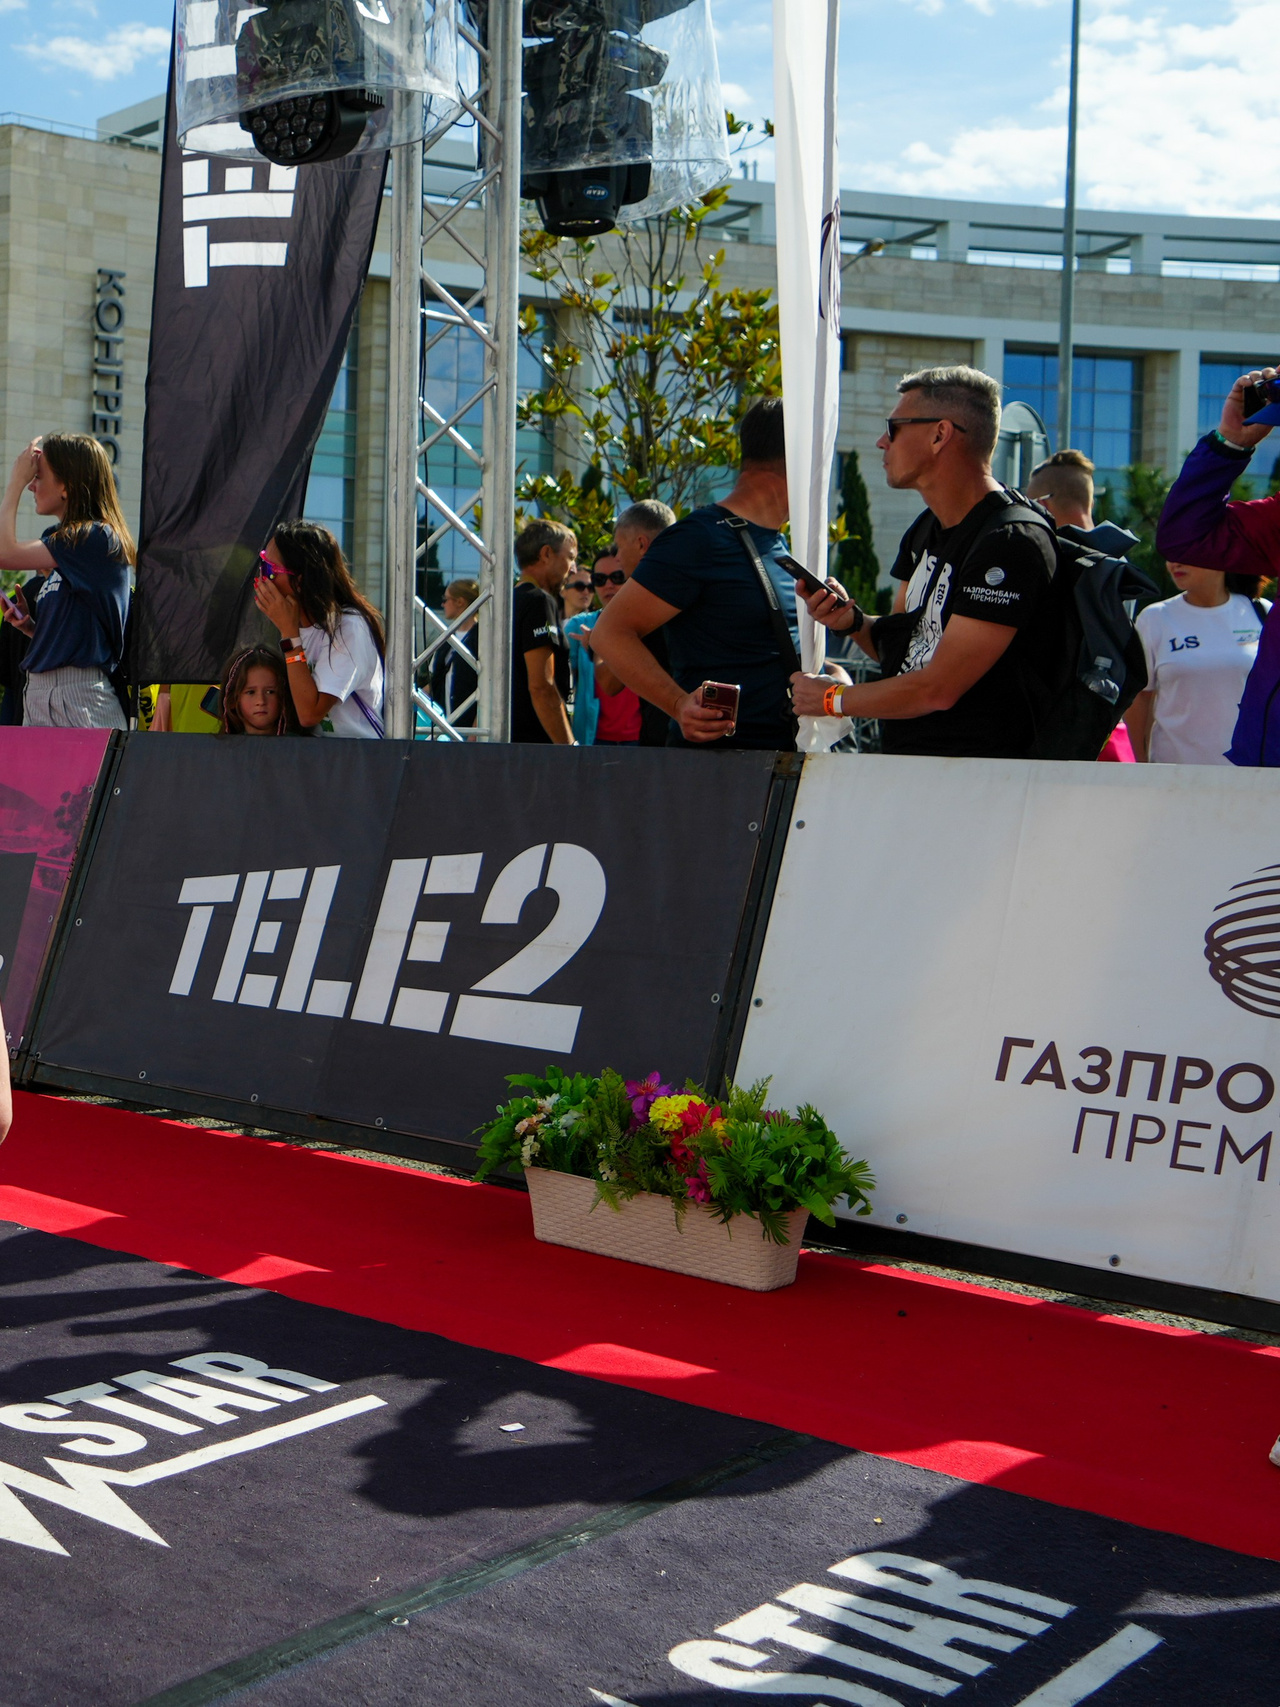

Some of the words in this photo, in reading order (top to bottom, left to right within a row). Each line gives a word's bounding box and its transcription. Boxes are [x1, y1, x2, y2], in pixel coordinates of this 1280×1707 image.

[93, 268, 126, 490] КОНГРЕС
[935, 583, 947, 606] 2023
[963, 586, 1021, 601] ГАЗПРОМБАНК
[970, 593, 1011, 605] ПРЕМИУМ
[1169, 635, 1200, 652] LS
[168, 842, 607, 1054] TELE2
[995, 1036, 1275, 1114] ГАЗПРО
[1072, 1106, 1273, 1182] ПРЕМ
[667, 1551, 1079, 1707] STAR
